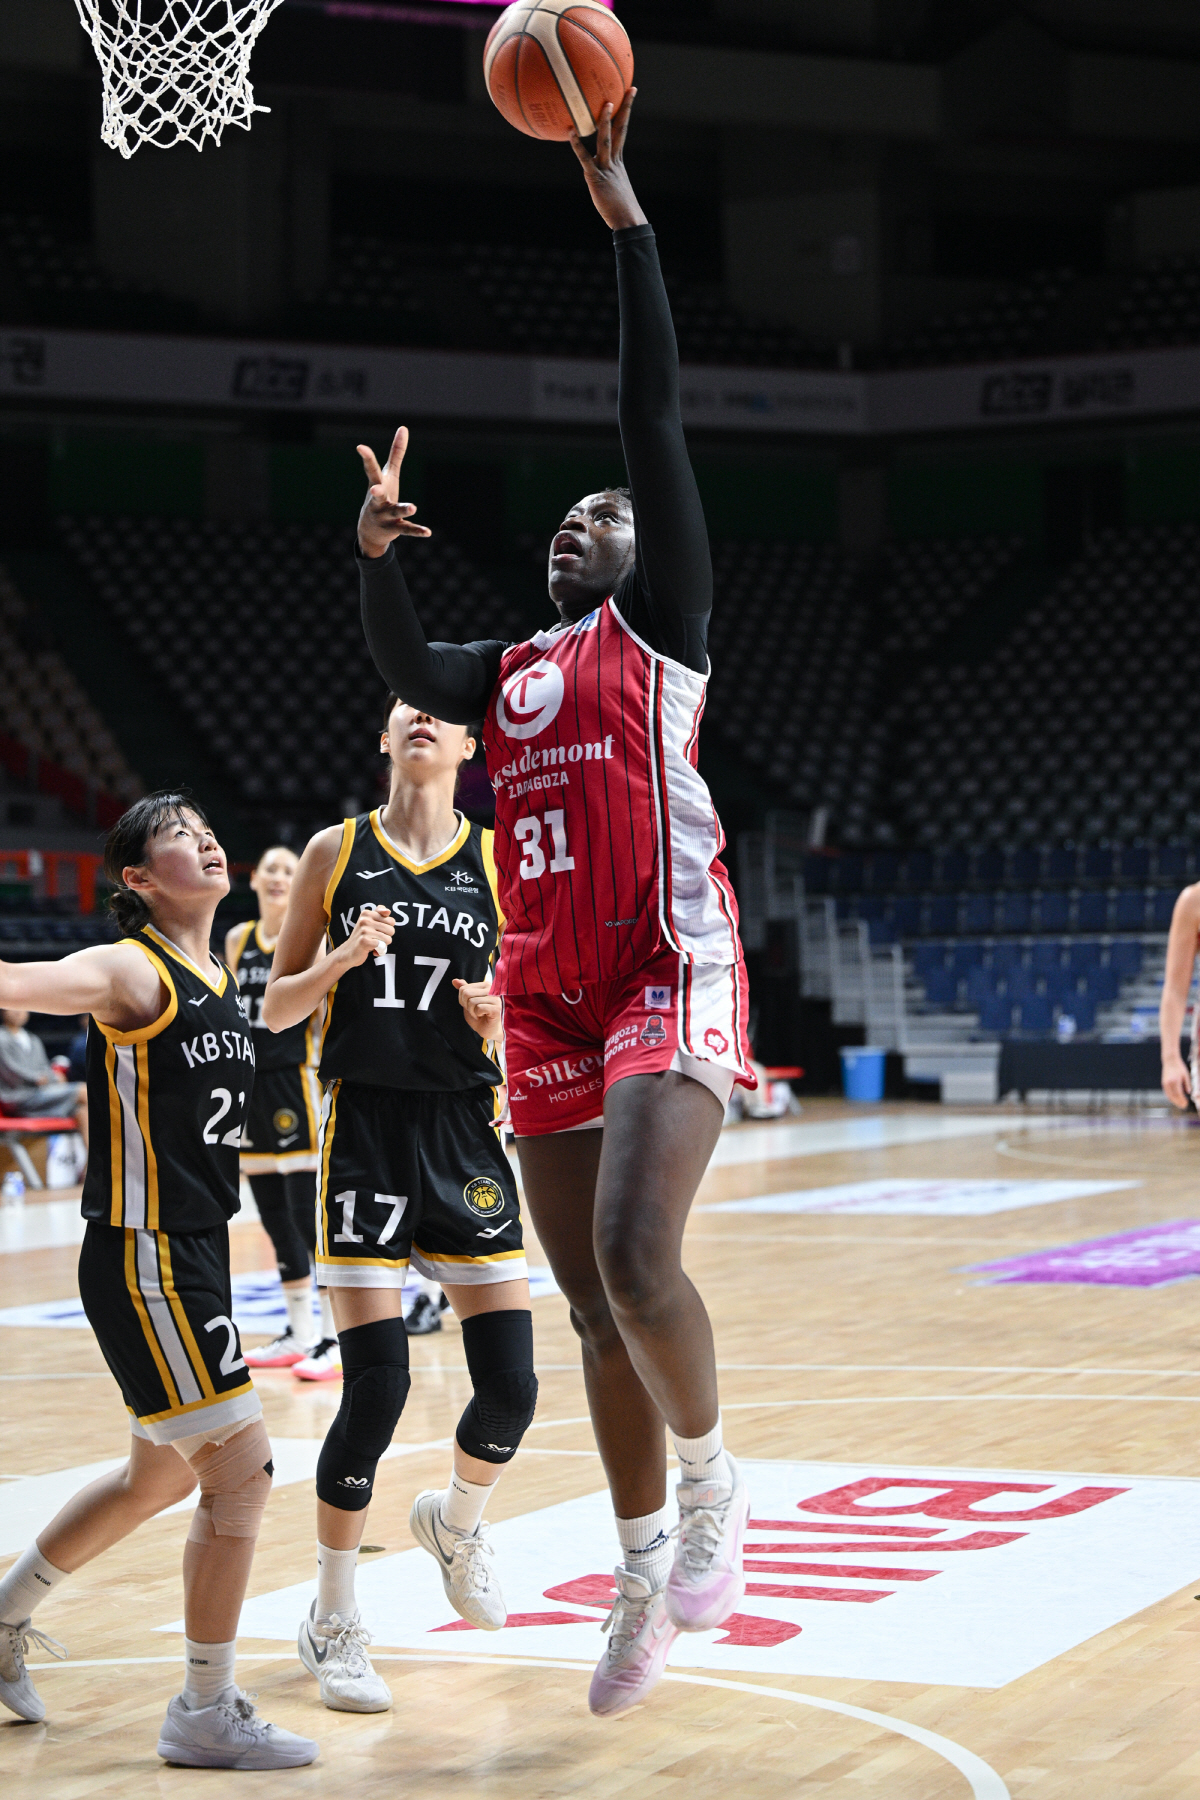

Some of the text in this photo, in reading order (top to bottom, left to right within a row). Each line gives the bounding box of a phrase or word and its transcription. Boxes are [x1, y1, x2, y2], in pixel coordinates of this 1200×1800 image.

[514, 809, 575, 880] 31
[392, 901, 489, 948] STARS
[373, 953, 451, 1011] 17
[181, 1032, 220, 1069] KB
[548, 1077, 603, 1104] HOTELES
[333, 1190, 409, 1245] 17
